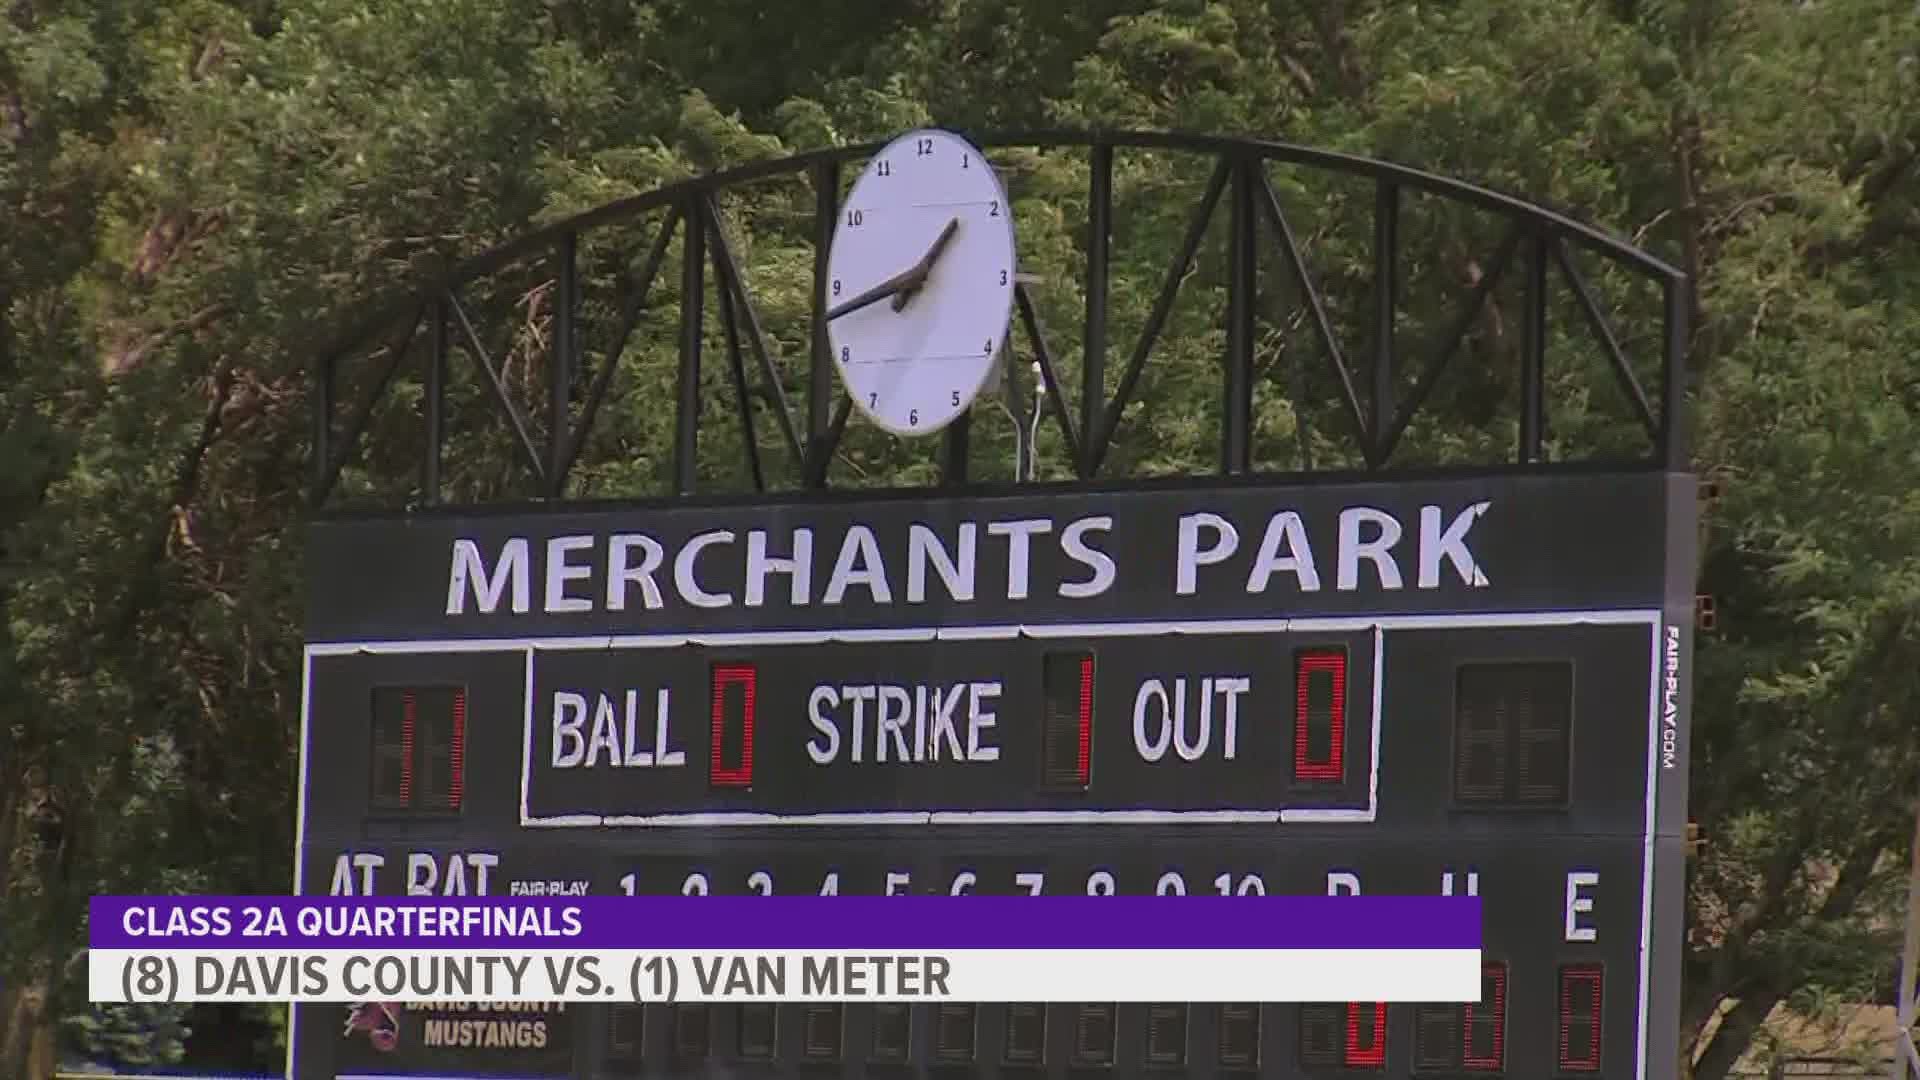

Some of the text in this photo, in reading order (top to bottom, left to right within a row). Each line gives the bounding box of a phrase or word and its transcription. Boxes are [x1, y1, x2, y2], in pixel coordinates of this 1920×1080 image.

[917, 139, 933, 156] 12
[877, 159, 890, 177] 11
[962, 154, 969, 169] 1
[989, 201, 999, 217] 2
[847, 210, 863, 227] 10
[999, 270, 1008, 286] 3
[832, 280, 841, 296] 9
[841, 347, 850, 363] 8
[984, 338, 992, 355] 4
[869, 393, 878, 409] 7
[951, 391, 960, 407] 5
[909, 410, 918, 426] 6
[446, 500, 1491, 615] MERCHANTS PARK
[710, 663, 757, 785] 0
[806, 681, 1001, 764] STRIKE
[1132, 677, 1250, 762] OUT
[1294, 650, 1346, 782] 0
[551, 688, 686, 768] BALL
[329, 853, 385, 896] AT
[1565, 872, 1599, 942] E
[423, 1019, 548, 1048] MUSTANGS
